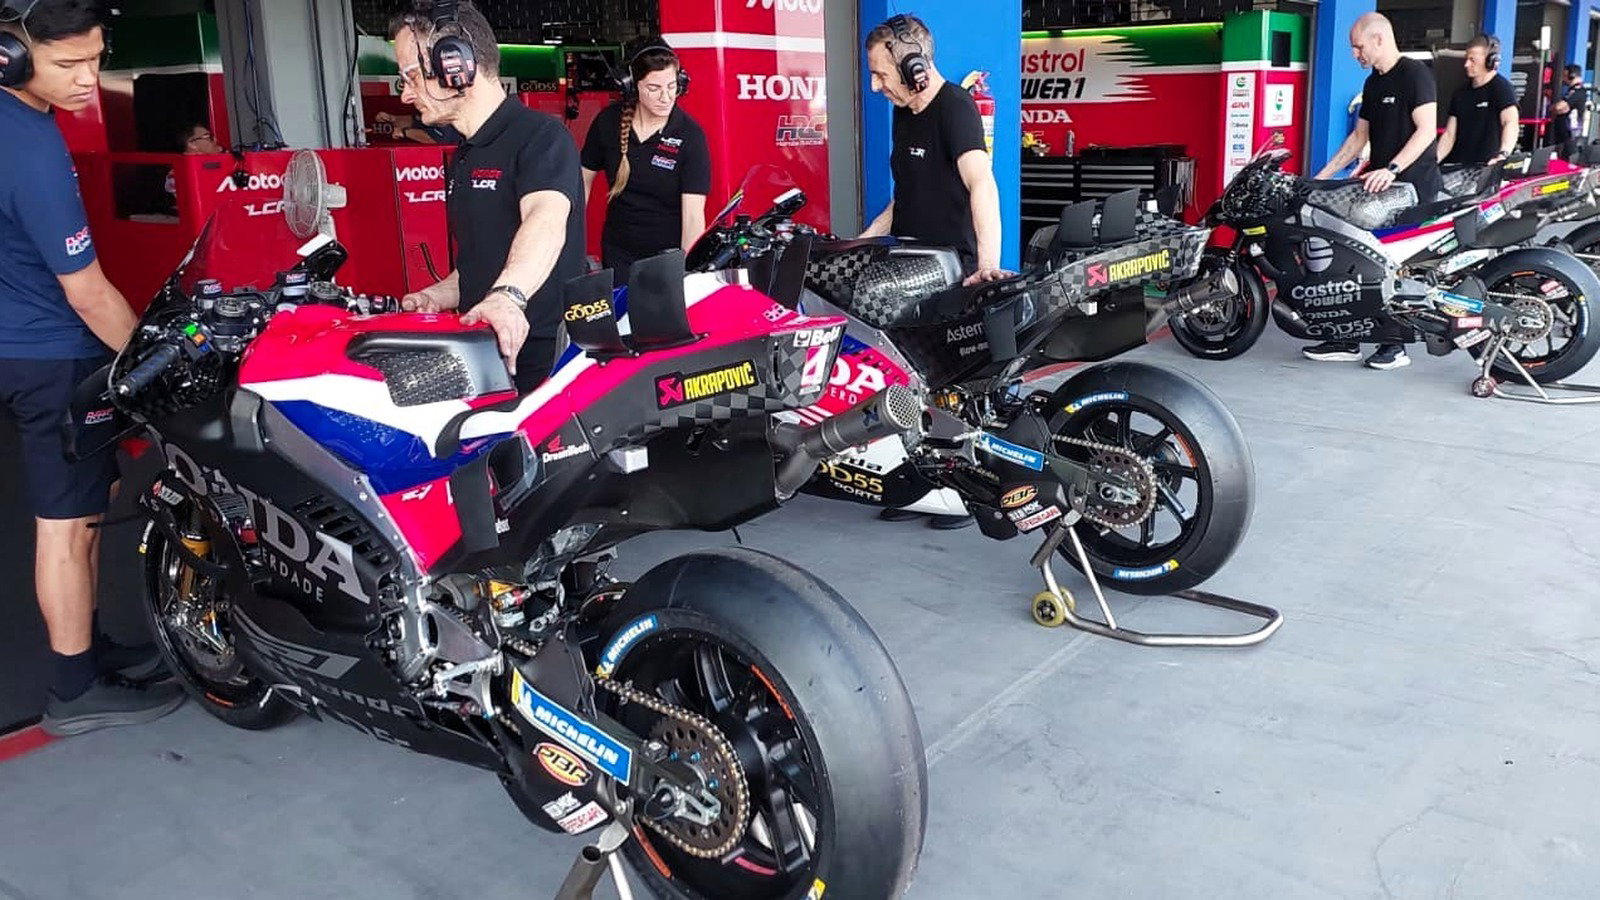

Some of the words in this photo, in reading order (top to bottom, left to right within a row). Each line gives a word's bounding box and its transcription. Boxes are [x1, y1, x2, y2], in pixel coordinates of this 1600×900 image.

[1291, 274, 1363, 300] Castrol
[564, 299, 610, 321] GOD55
[991, 443, 1037, 464] MICHELIN
[607, 618, 654, 662] MICHELIN
[534, 705, 620, 765] MICHELIN
